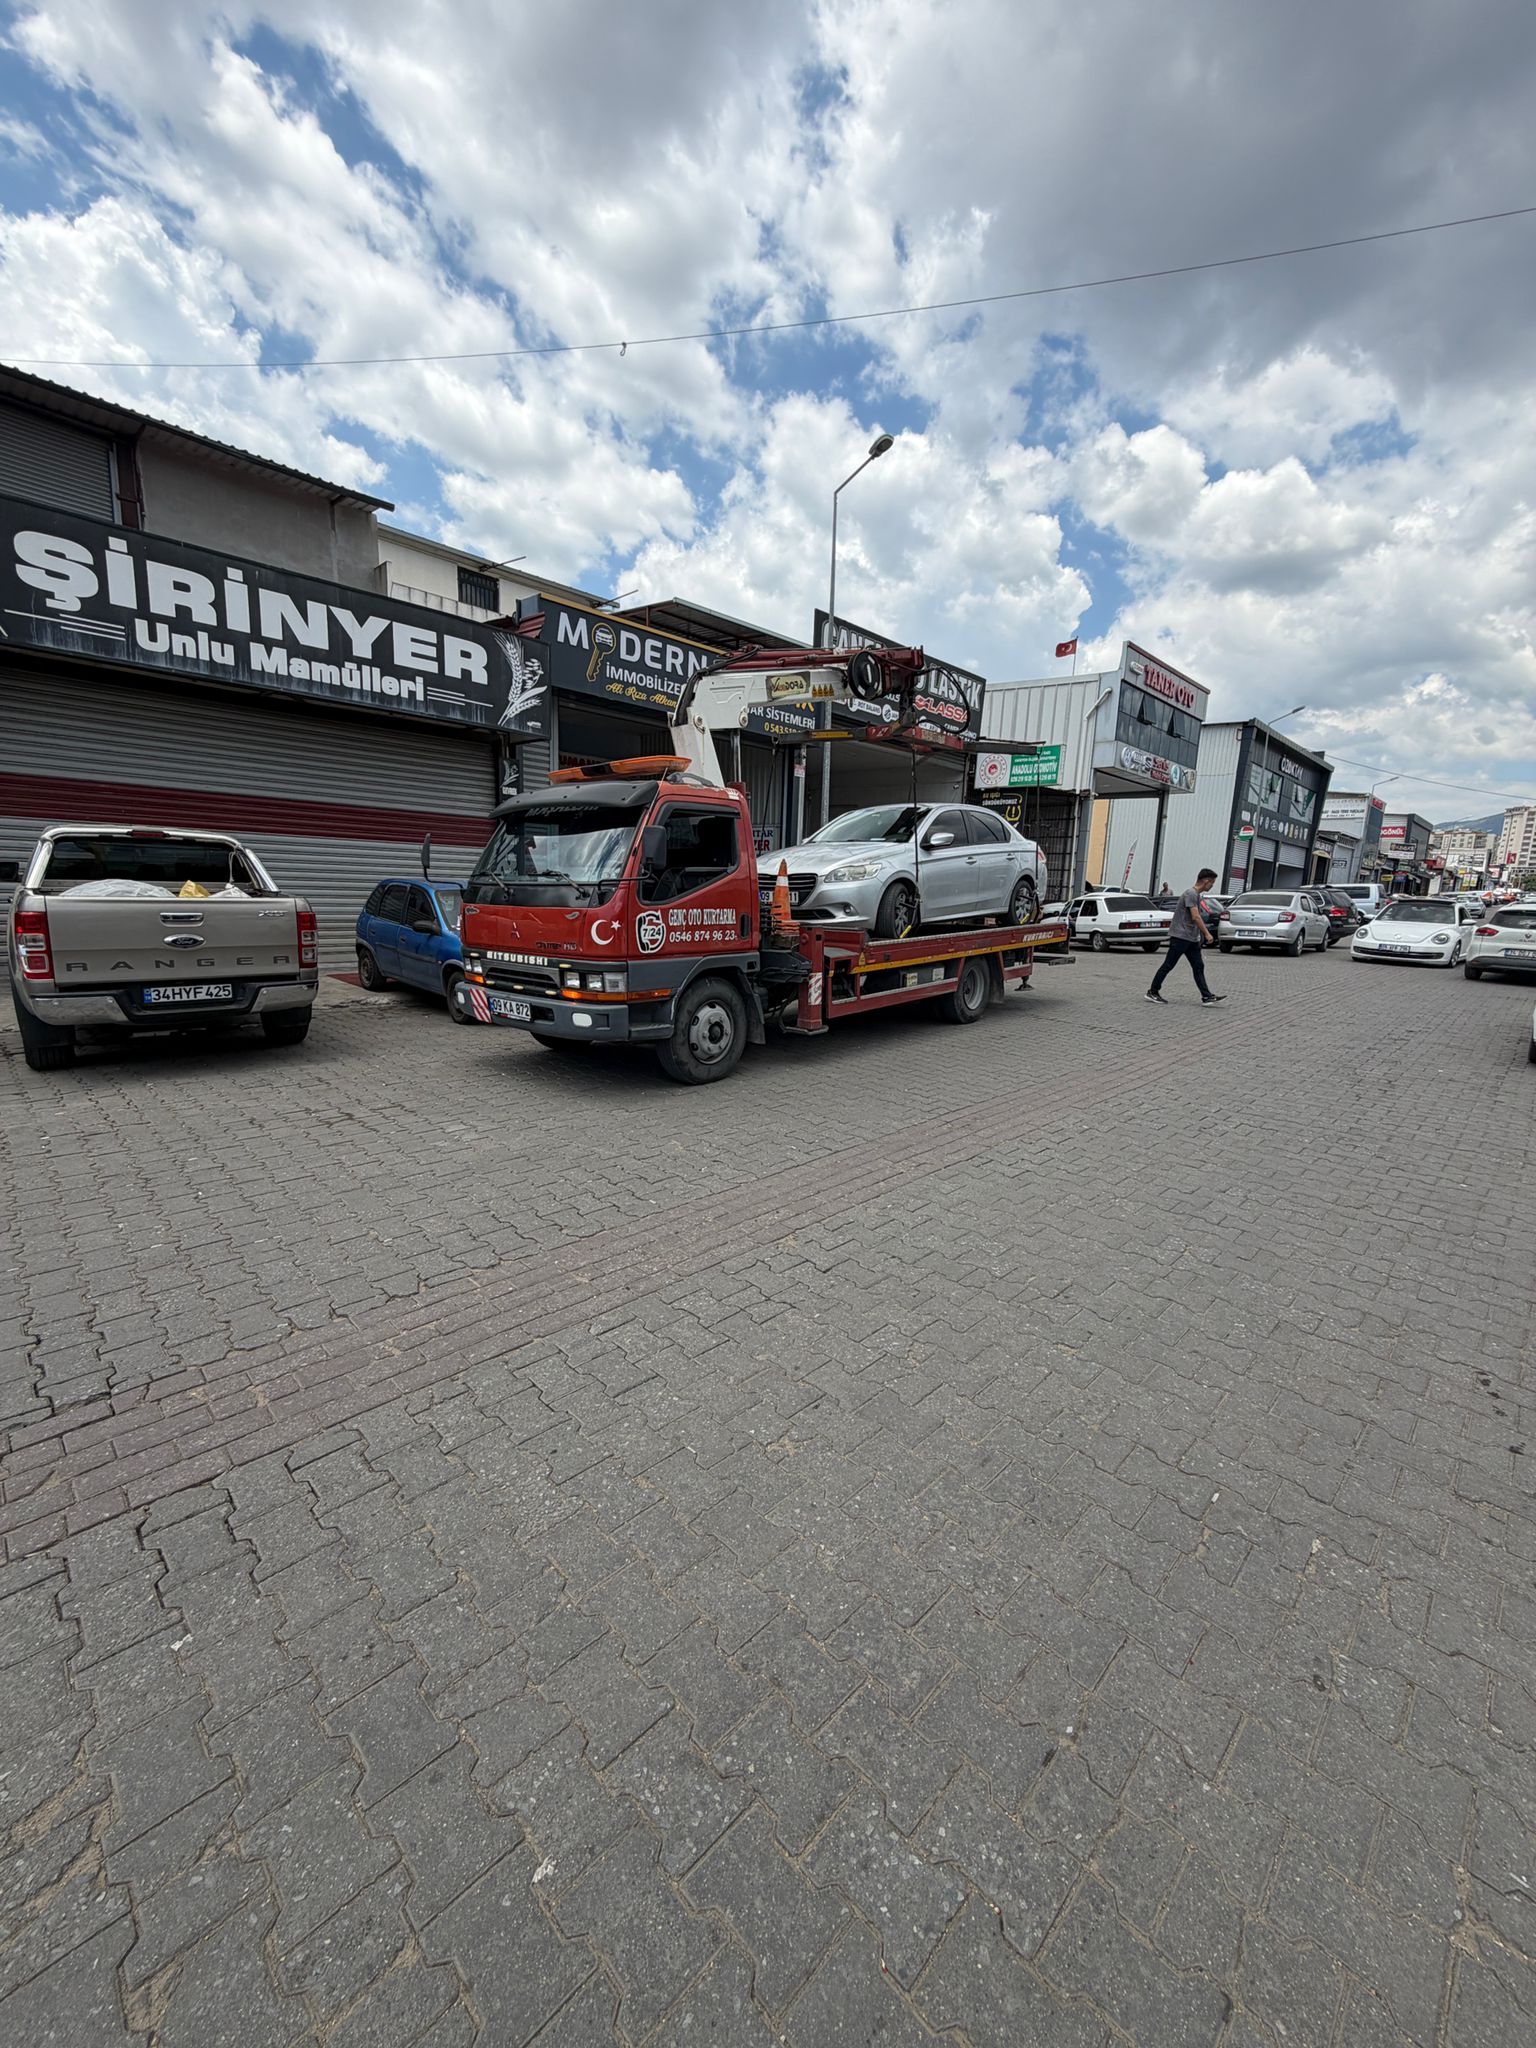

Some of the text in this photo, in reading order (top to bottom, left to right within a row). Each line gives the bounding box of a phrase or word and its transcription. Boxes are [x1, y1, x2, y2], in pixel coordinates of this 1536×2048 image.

[13, 530, 489, 686] ŞİRİNYER
[135, 620, 425, 702] Unlu Mamülleri
[929, 666, 982, 711] LASTİK
[1145, 665, 1175, 699] TANER
[1177, 686, 1195, 708] OTO
[766, 706, 816, 730] SİSTEMLERİ
[668, 908, 737, 931] GENÇ OTO KURTARMA
[176, 938, 194, 946] Ford
[642, 927, 662, 938] 7/24
[669, 930, 692, 943] 0546
[694, 930, 711, 942] 874
[712, 930, 723, 941] 96
[66, 955, 290, 971] RANGER
[486, 950, 549, 967] MITSUBISHI
[504, 1000, 515, 1014] KA
[516, 1002, 531, 1018] 872
